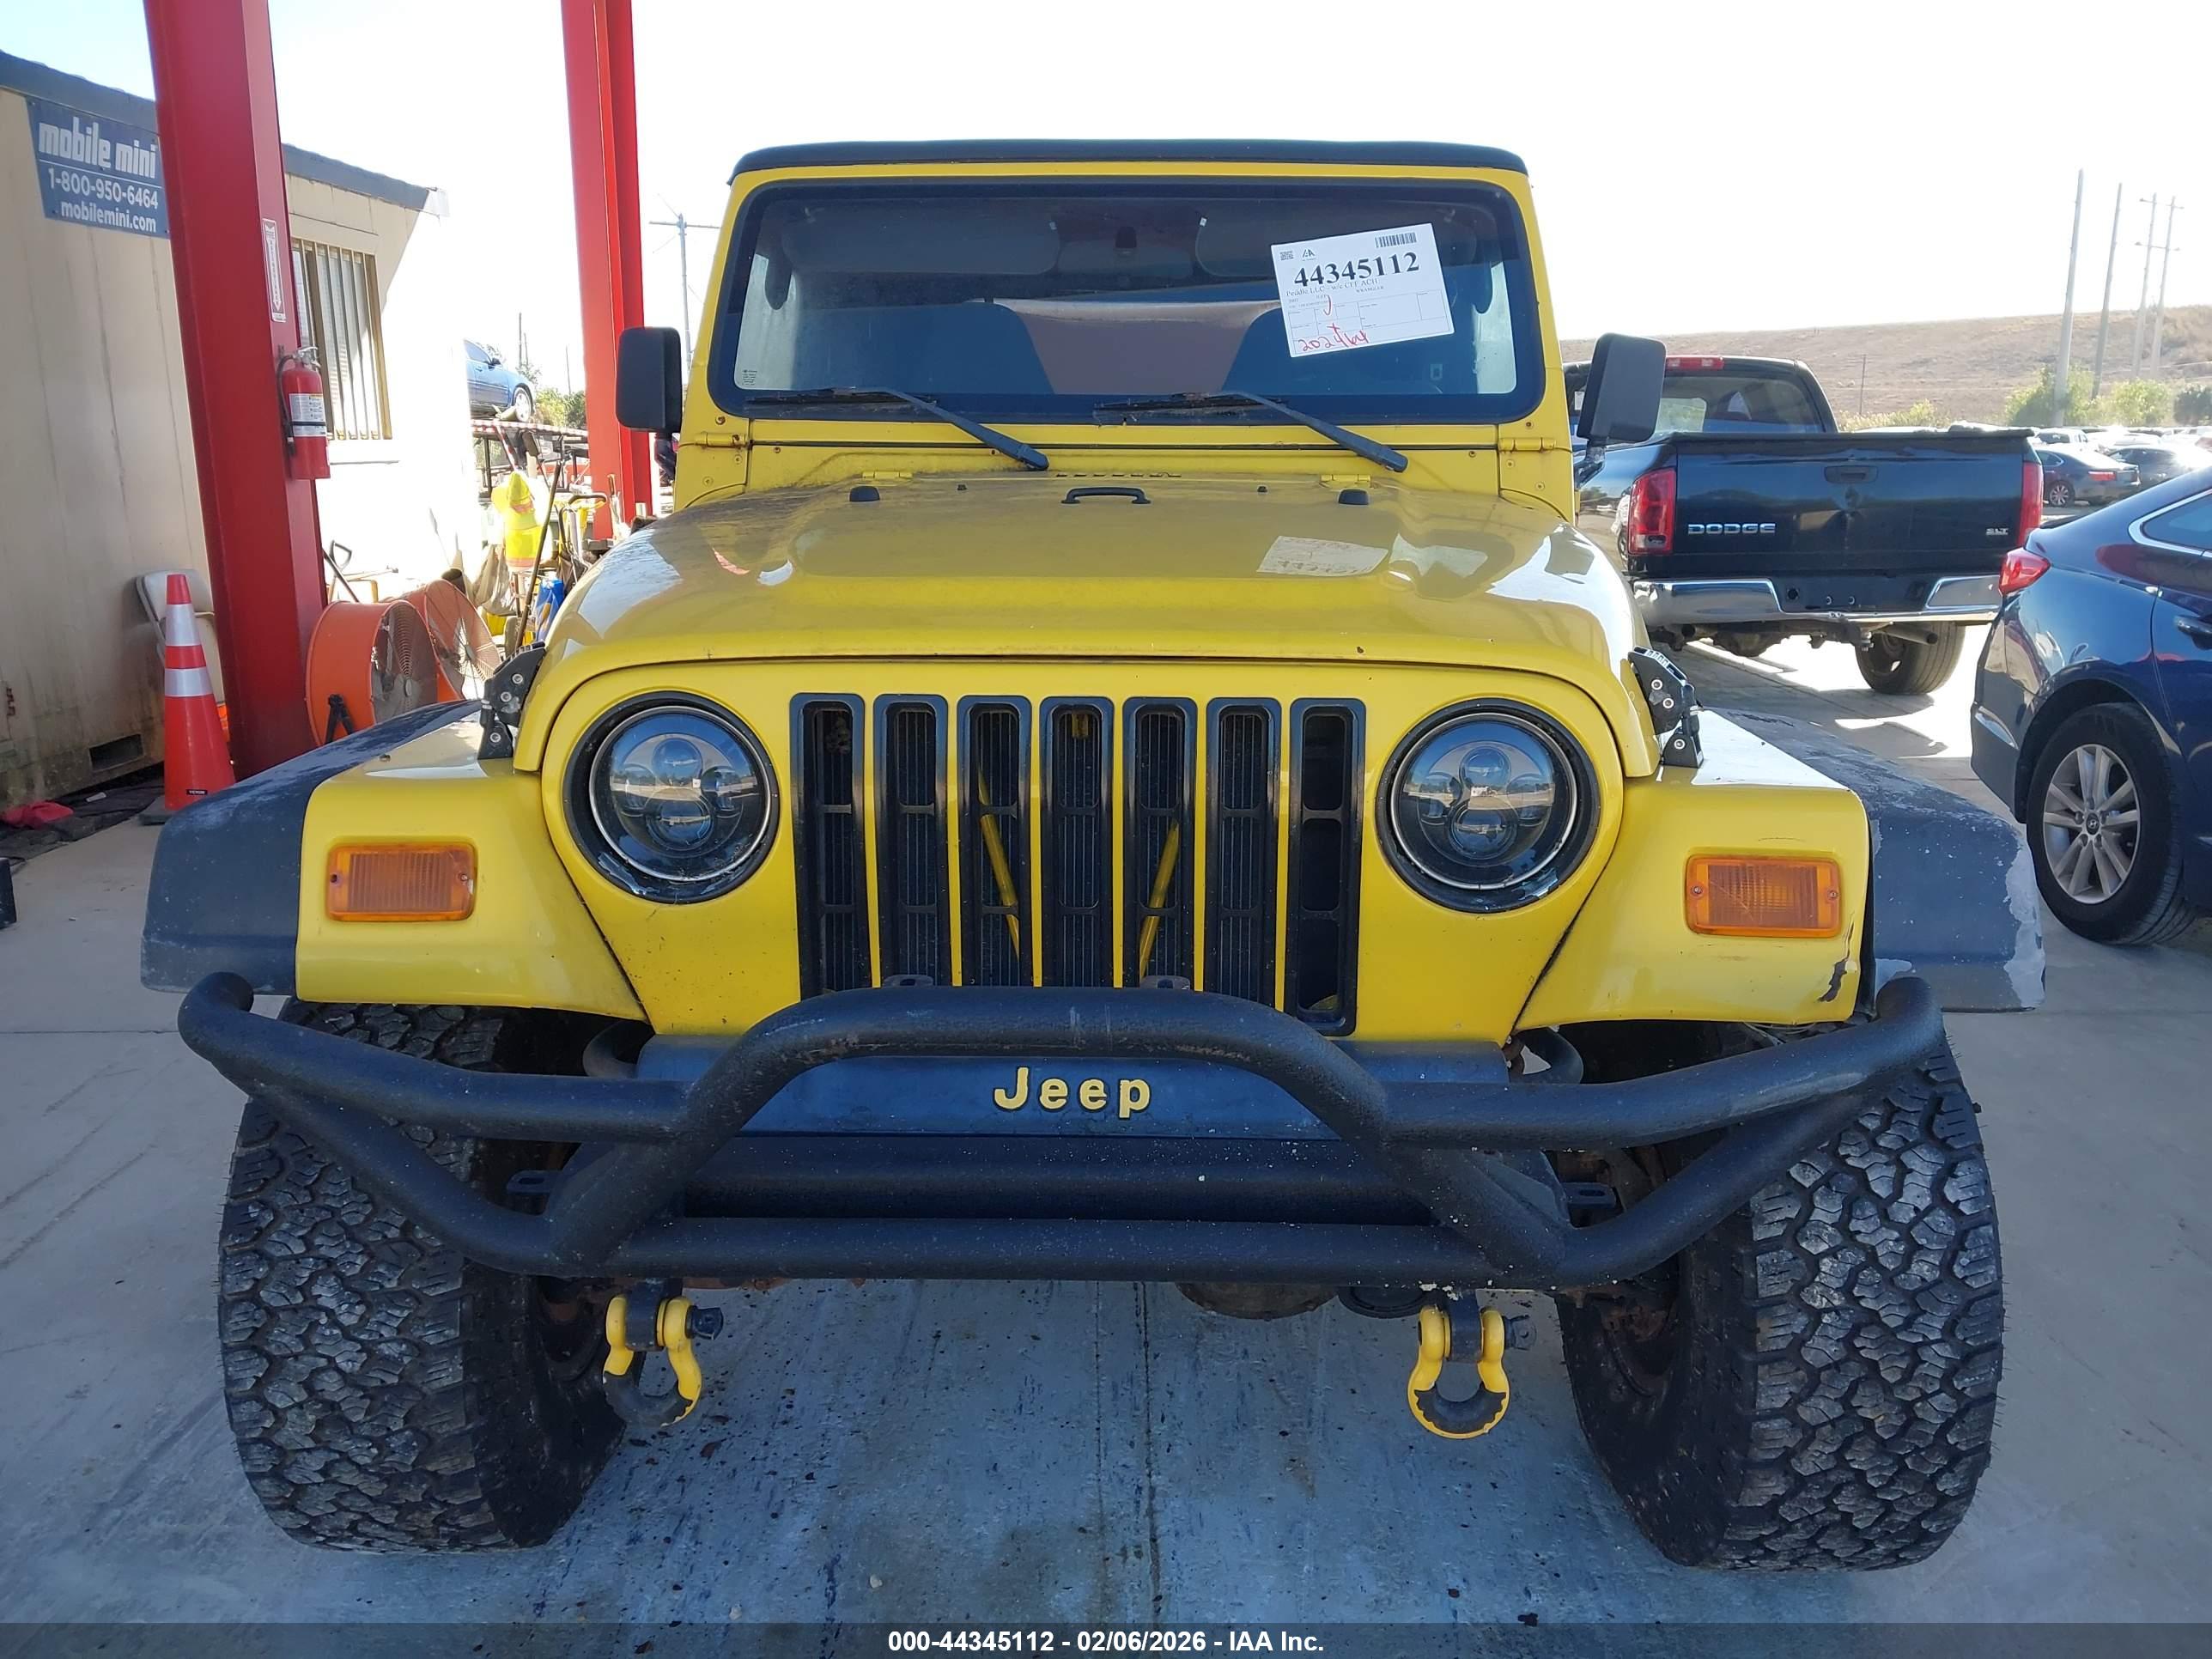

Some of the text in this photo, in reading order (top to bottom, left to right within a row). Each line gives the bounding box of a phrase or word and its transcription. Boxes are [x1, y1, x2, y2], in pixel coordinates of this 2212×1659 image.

[39, 116, 156, 179] mobile mini
[48, 168, 159, 209] 1-800-950-6464
[61, 201, 157, 233] mobilemini.com
[1294, 252, 1420, 287] 44345112
[1687, 523, 1776, 534] DODGE
[1985, 527, 2009, 536] SLT
[994, 1066, 1152, 1119] Jeep
